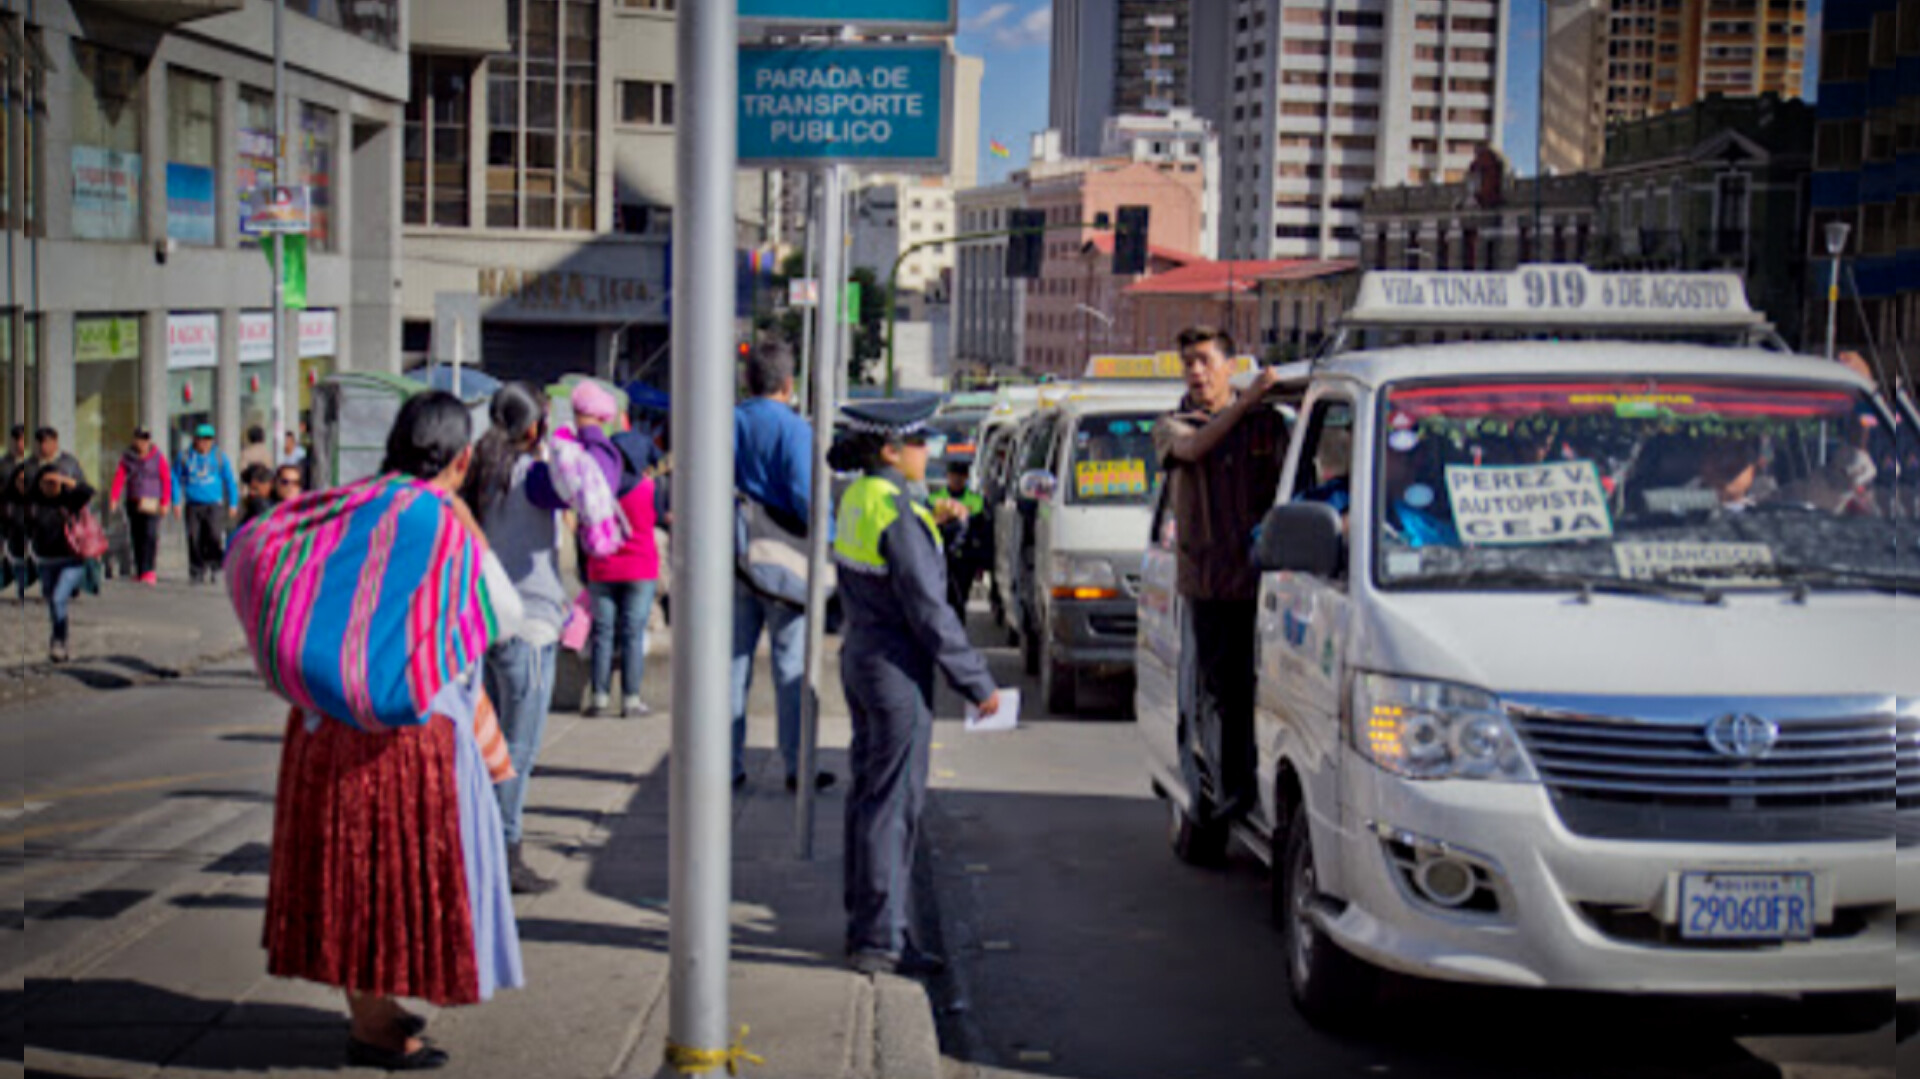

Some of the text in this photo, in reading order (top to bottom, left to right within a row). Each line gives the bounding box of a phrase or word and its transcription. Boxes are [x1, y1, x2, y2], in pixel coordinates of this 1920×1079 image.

[756, 66, 910, 90] PARADA DE
[743, 94, 922, 116] TRANSPORTE
[770, 120, 892, 142] PUBLICO
[1381, 270, 1729, 309] Villa TUNARI 919 6 DE AGOSTO
[1452, 469, 1553, 491] PEREZ
[1458, 490, 1597, 514] AUTOPISTA
[1465, 513, 1602, 538] CEJA
